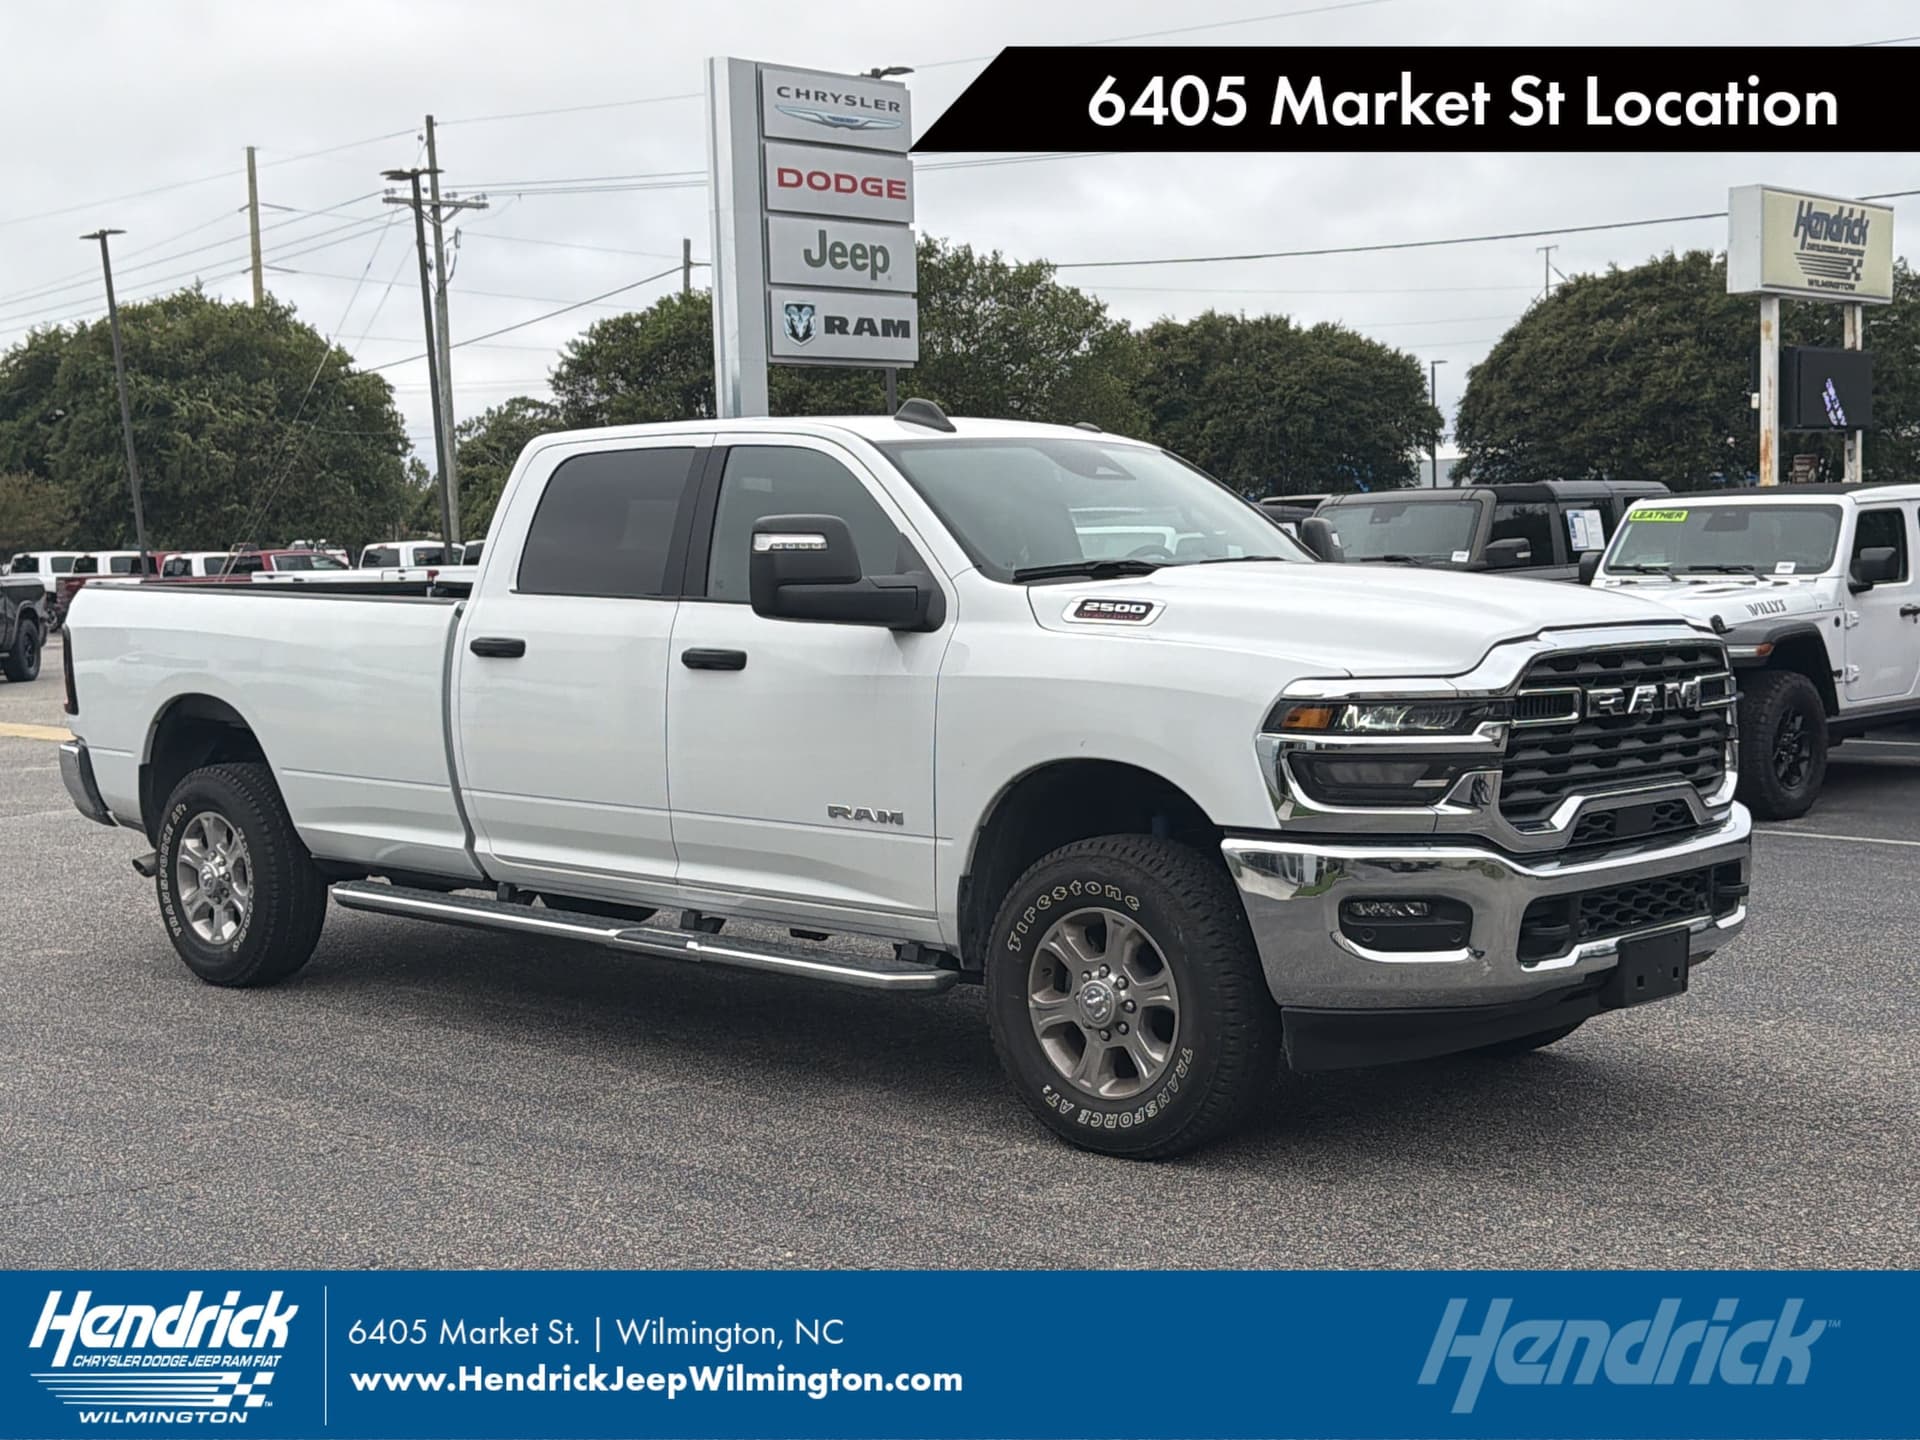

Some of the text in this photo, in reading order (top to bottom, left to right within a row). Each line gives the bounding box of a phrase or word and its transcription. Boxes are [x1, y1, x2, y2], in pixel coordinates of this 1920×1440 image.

[776, 86, 901, 113] CHRYSLER
[777, 167, 907, 200] DODGE
[1793, 200, 1870, 250] Hendrick
[803, 229, 890, 280] Jeep
[1807, 278, 1856, 291] WILMINGTON
[824, 315, 911, 338] RAM
[1631, 510, 1685, 520] LEATHER
[1083, 602, 1147, 614] 2500
[1745, 599, 1786, 616] WILLYS
[1586, 679, 1701, 718] RAM
[827, 804, 904, 825] RAM
[1007, 880, 1140, 952] Firestone
[1078, 1047, 1193, 1129] TRANSFORCE
